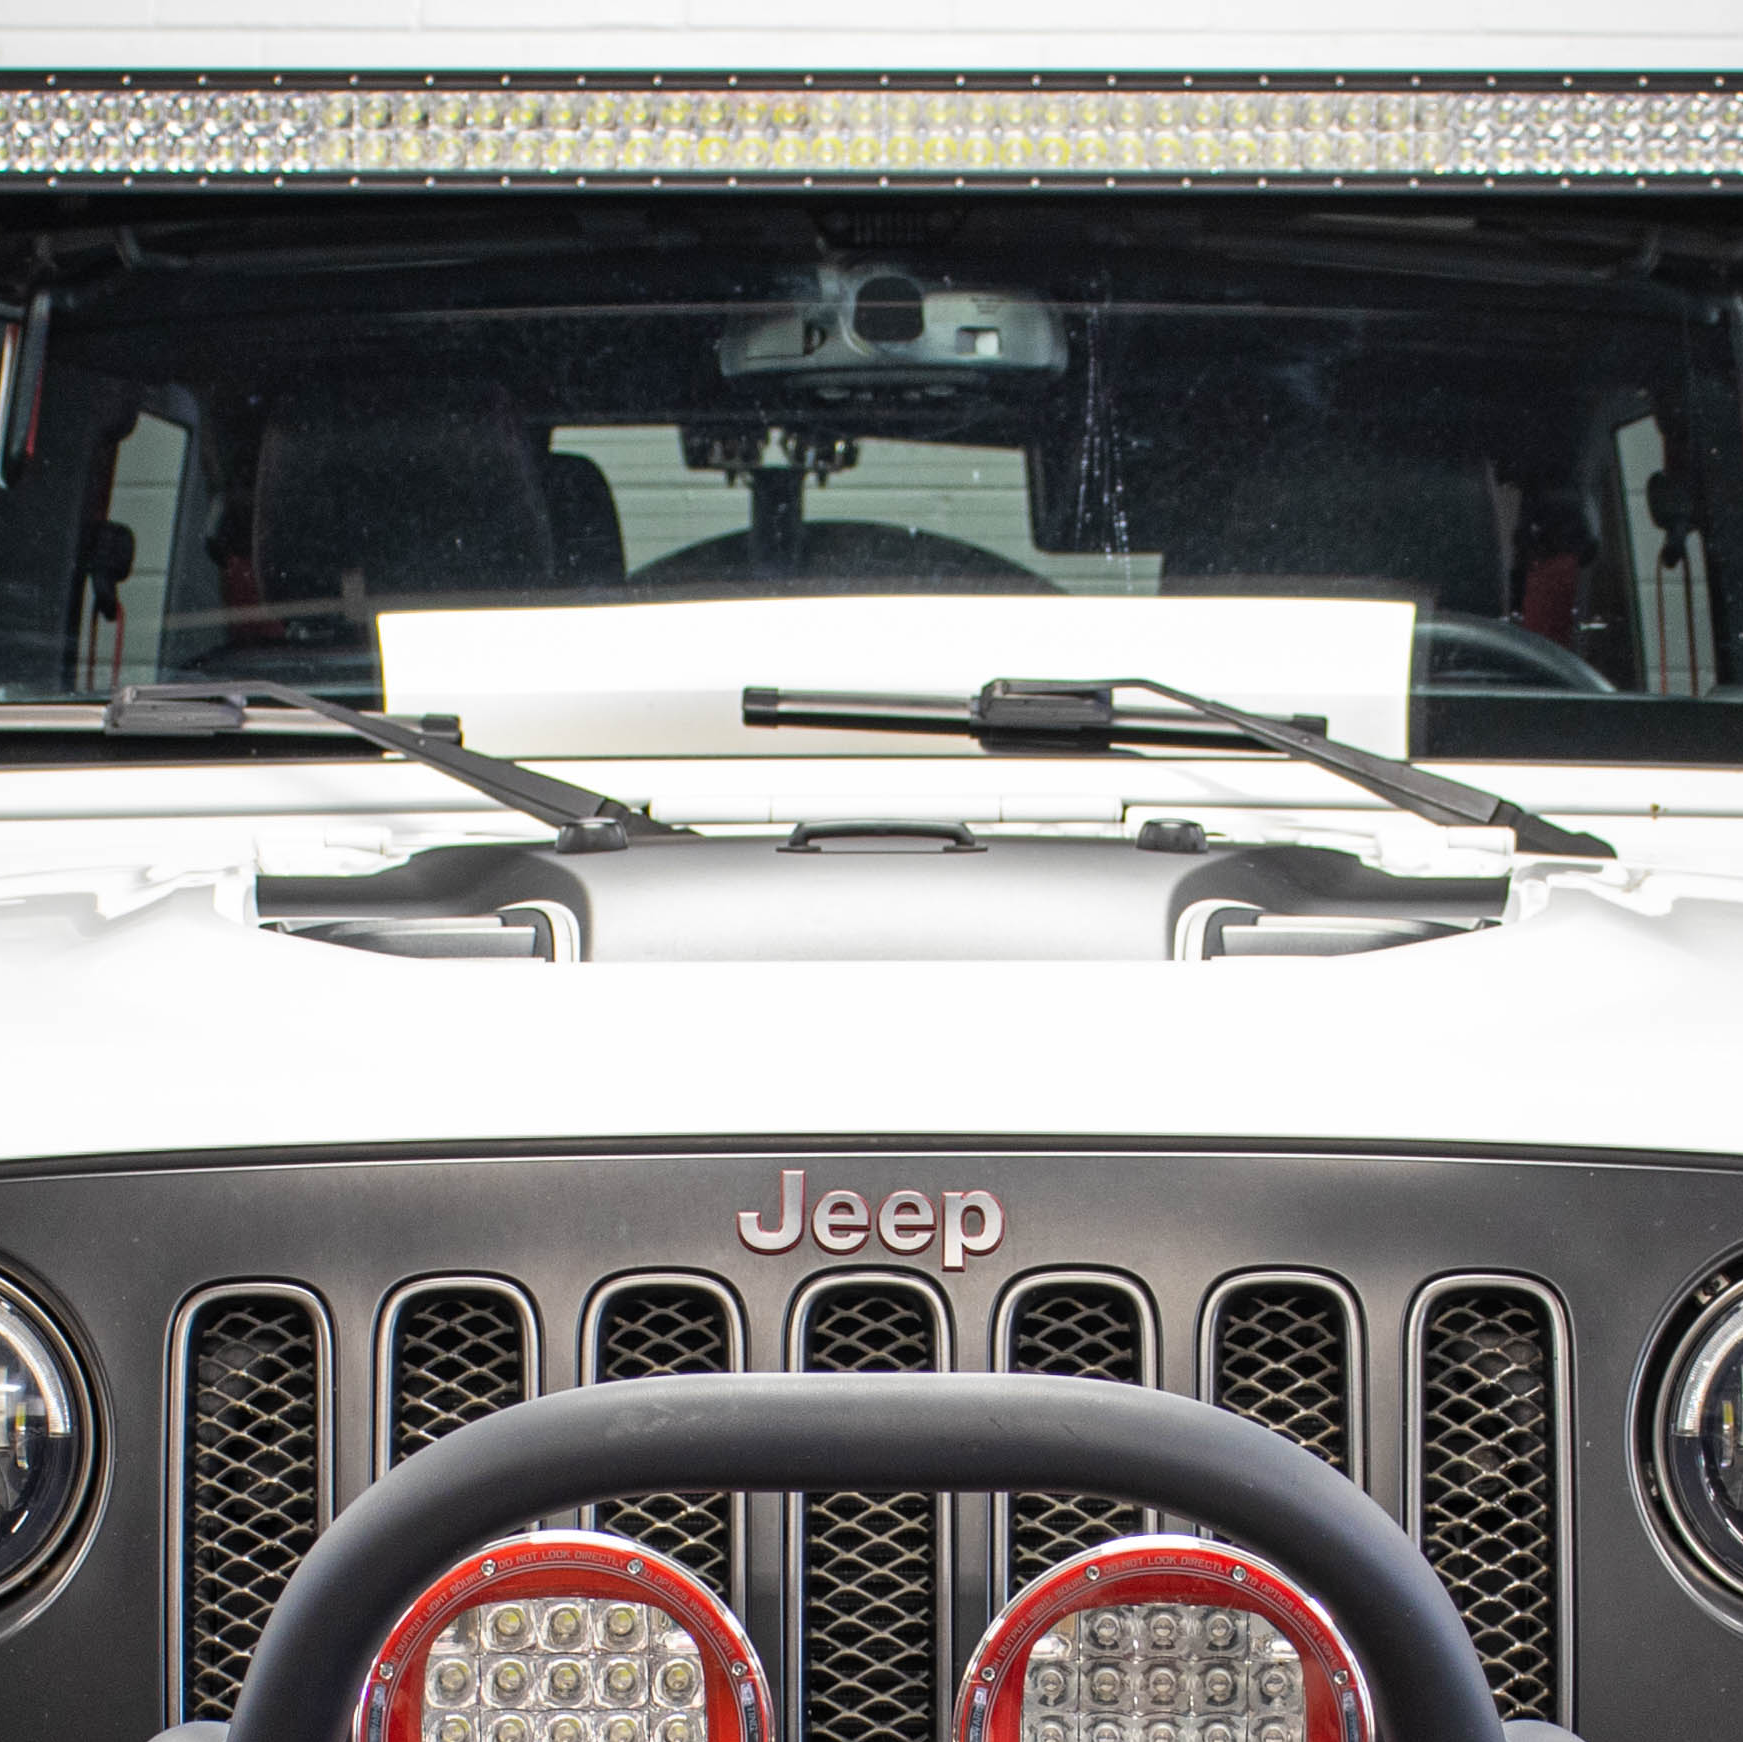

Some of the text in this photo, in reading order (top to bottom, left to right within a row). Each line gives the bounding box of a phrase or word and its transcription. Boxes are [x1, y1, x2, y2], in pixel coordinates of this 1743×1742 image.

[737, 1169, 1006, 1272] Jeep
[450, 1569, 485, 1593] SOURC
[497, 1558, 513, 1571] DO
[516, 1551, 539, 1564] NOT
[541, 1550, 571, 1562] LOOK
[574, 1551, 628, 1568] DIRECTLY
[653, 1575, 688, 1602] OPTICS
[1000, 1620, 1028, 1659] OUTPUT
[1121, 1557, 1144, 1570] NOT
[1147, 1555, 1178, 1567] LOOK
[1180, 1557, 1232, 1574] DIRECTLY
[1246, 1574, 1259, 1587] TO
[1260, 1582, 1295, 1608] OPTICS
